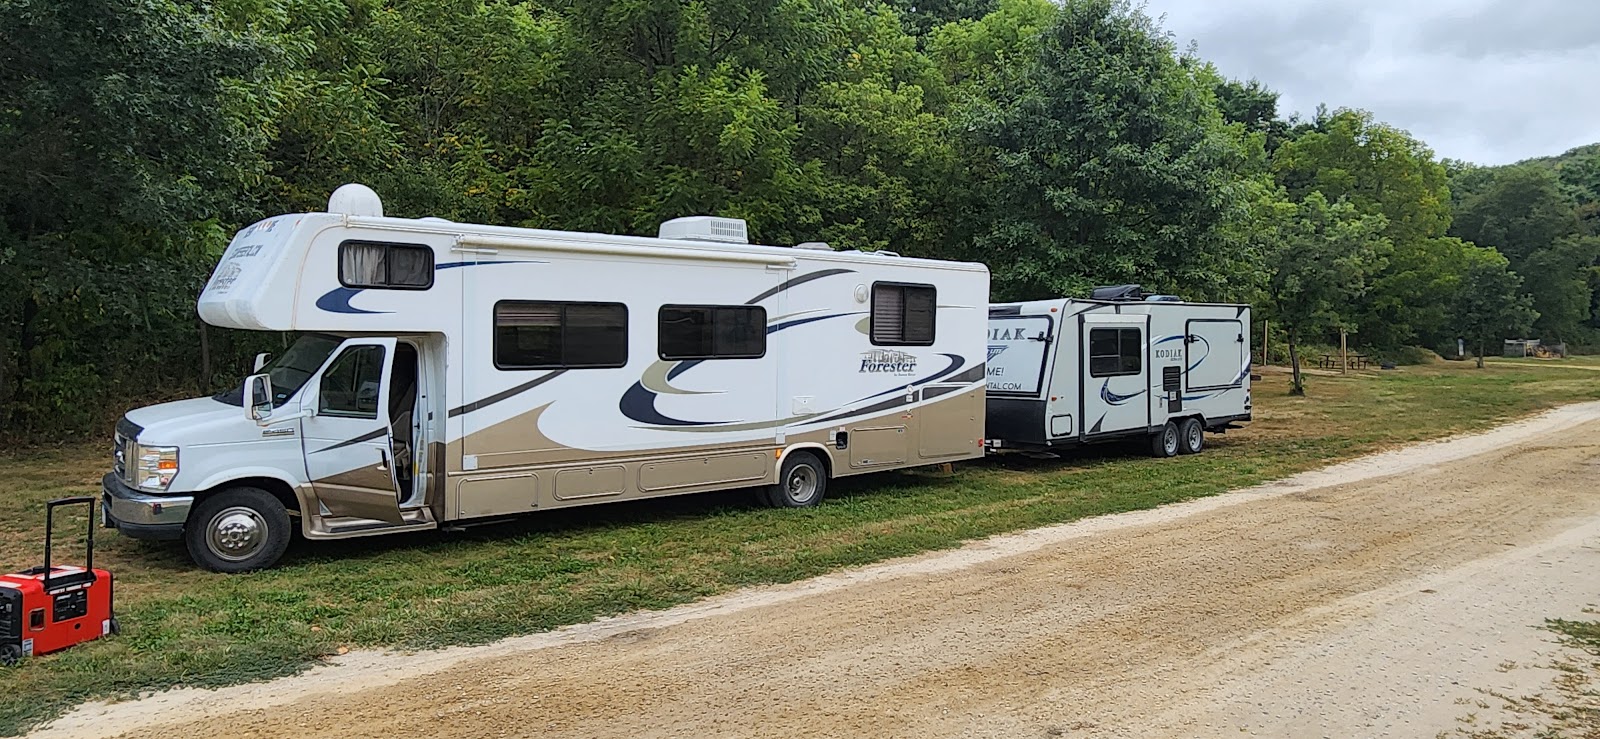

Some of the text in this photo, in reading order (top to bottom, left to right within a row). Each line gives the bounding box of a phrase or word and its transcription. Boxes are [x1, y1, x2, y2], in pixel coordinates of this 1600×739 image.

[988, 328, 1026, 340] IAK
[1155, 349, 1182, 358] KODIAK
[859, 359, 917, 373] Forester
[987, 367, 1004, 376] ME!
